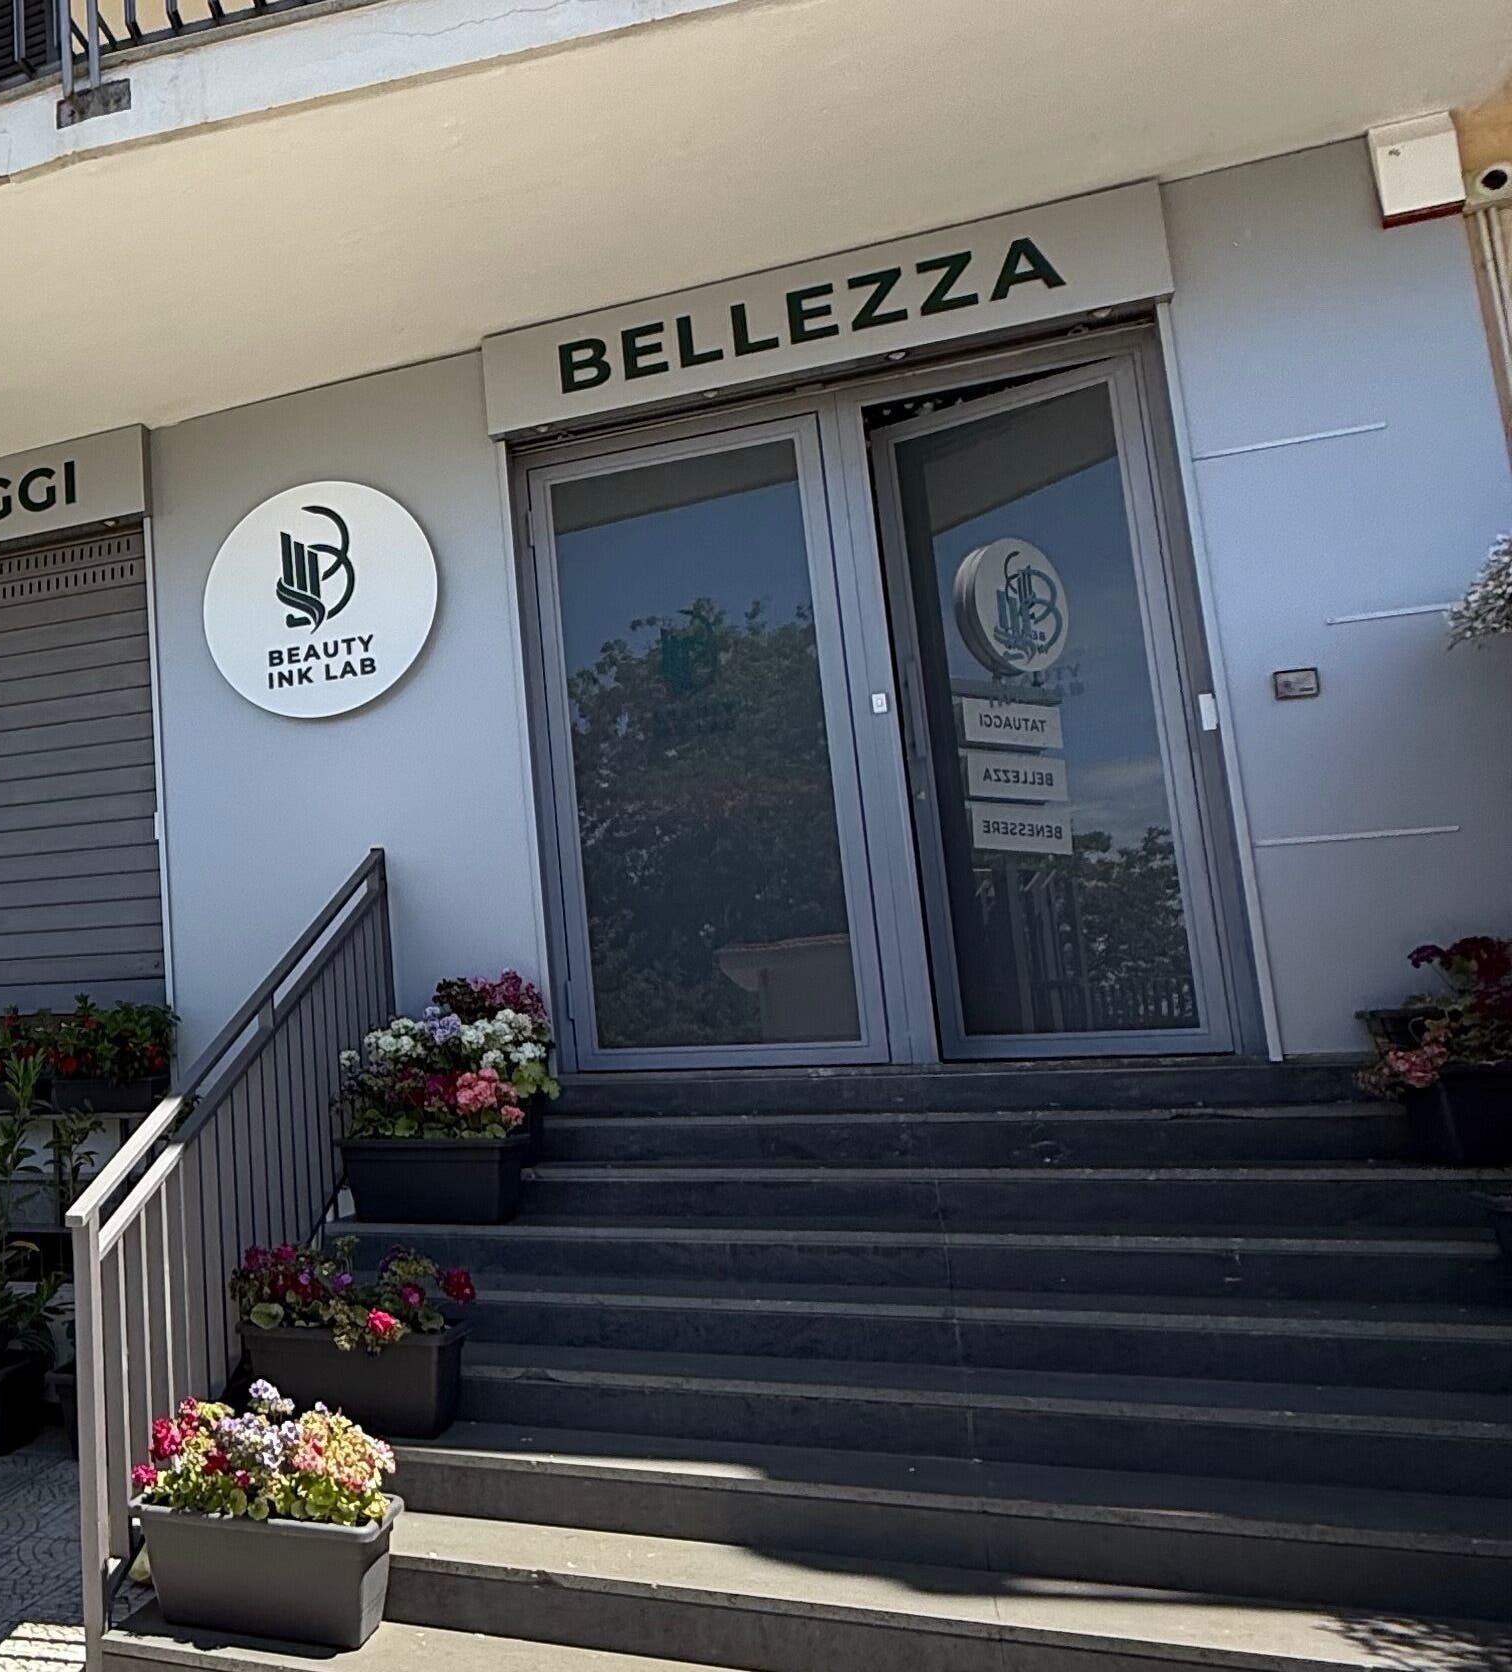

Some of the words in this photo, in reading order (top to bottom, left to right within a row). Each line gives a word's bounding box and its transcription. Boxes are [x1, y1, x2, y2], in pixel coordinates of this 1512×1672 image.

[557, 237, 1067, 395] BELLEZZA
[268, 634, 374, 667] BEAUTY
[268, 666, 314, 690] INK
[324, 657, 377, 681] LAB
